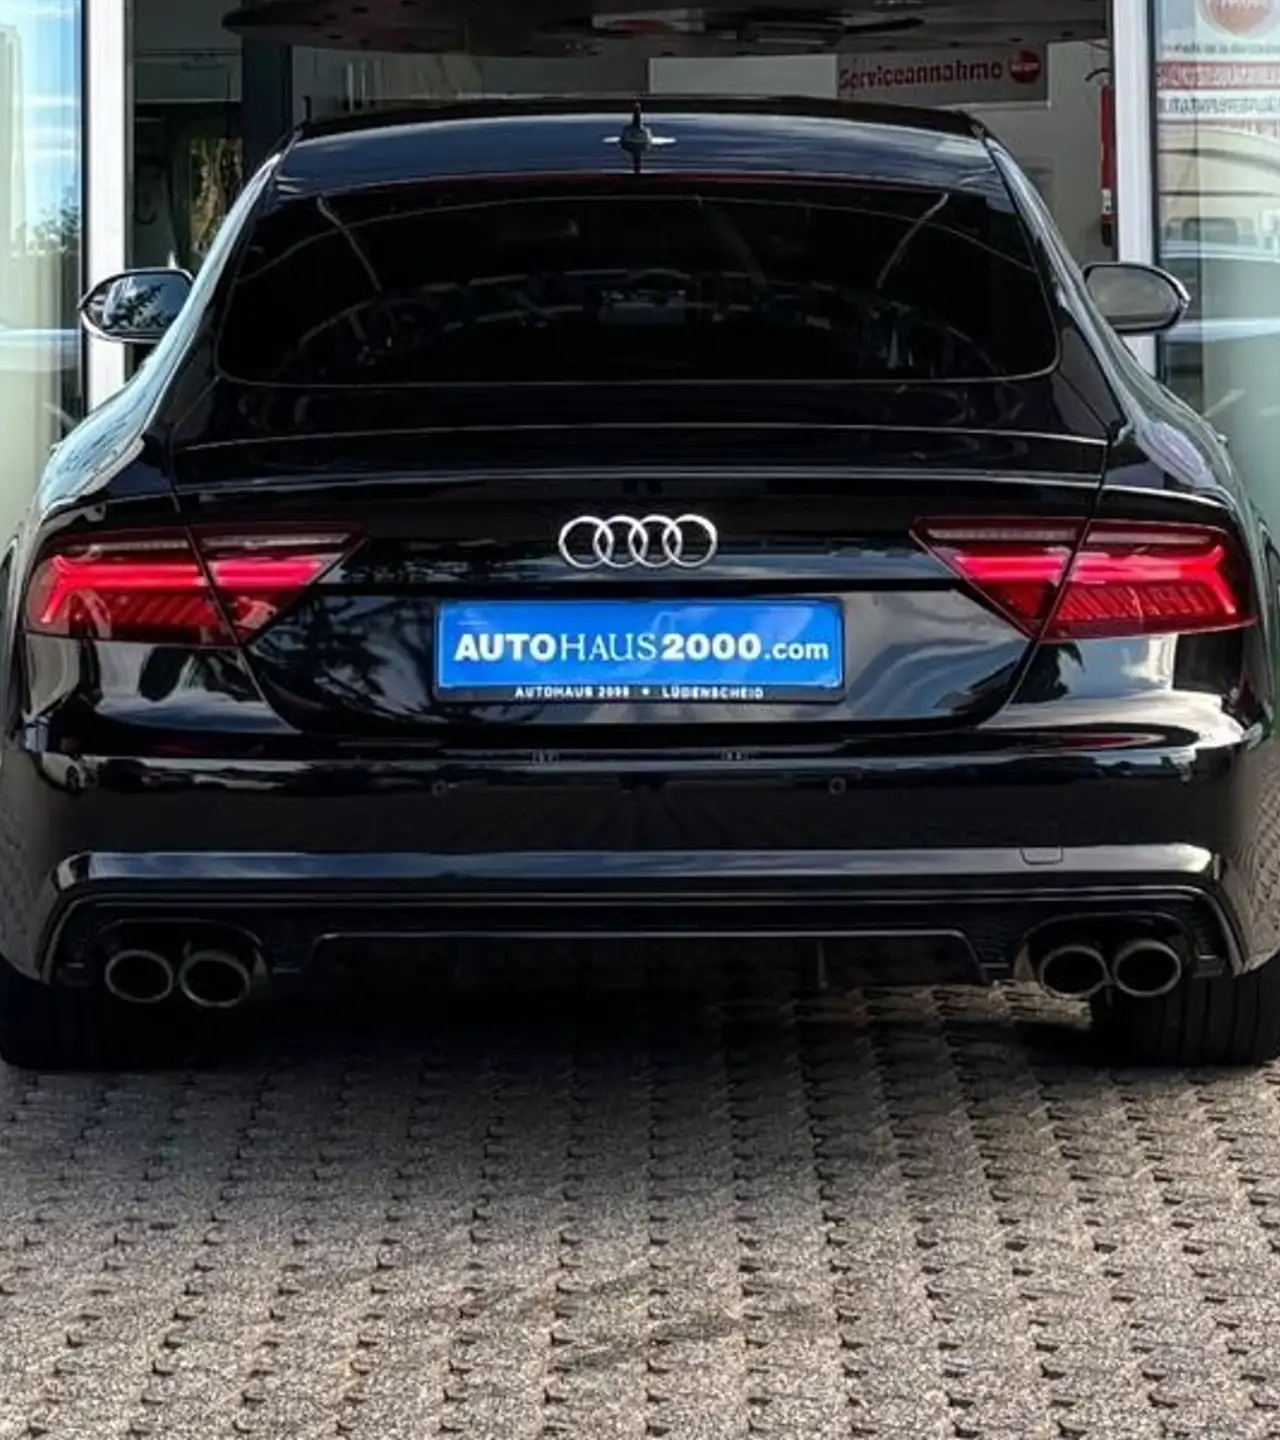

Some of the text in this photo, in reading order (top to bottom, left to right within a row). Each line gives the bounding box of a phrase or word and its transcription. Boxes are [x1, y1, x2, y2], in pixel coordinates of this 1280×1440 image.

[839, 60, 1004, 90] Serviceannahme
[454, 632, 829, 662] AUTOHAUS2000.com
[514, 686, 593, 699] AUTOHAUS
[661, 685, 765, 700] LÜDENSCHEID
